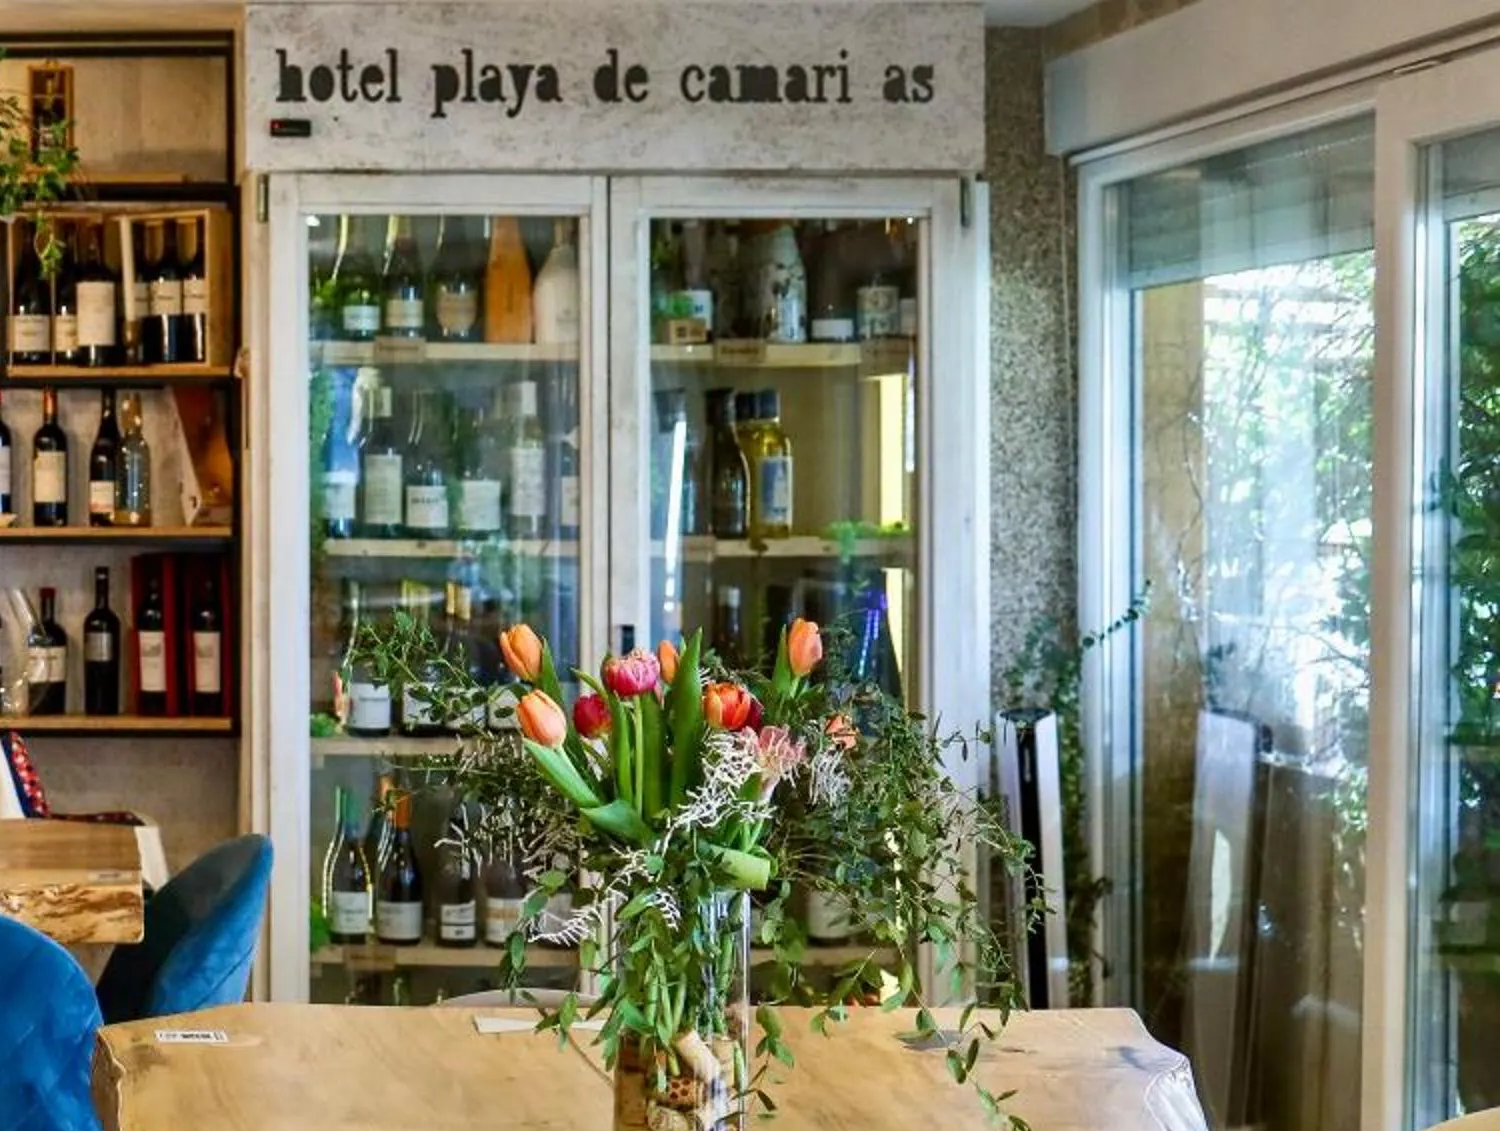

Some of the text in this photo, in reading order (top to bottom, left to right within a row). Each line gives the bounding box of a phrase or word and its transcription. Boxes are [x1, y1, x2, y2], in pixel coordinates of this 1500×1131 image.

[275, 48, 402, 103] hotel
[430, 48, 564, 118] playa
[592, 48, 650, 103] de
